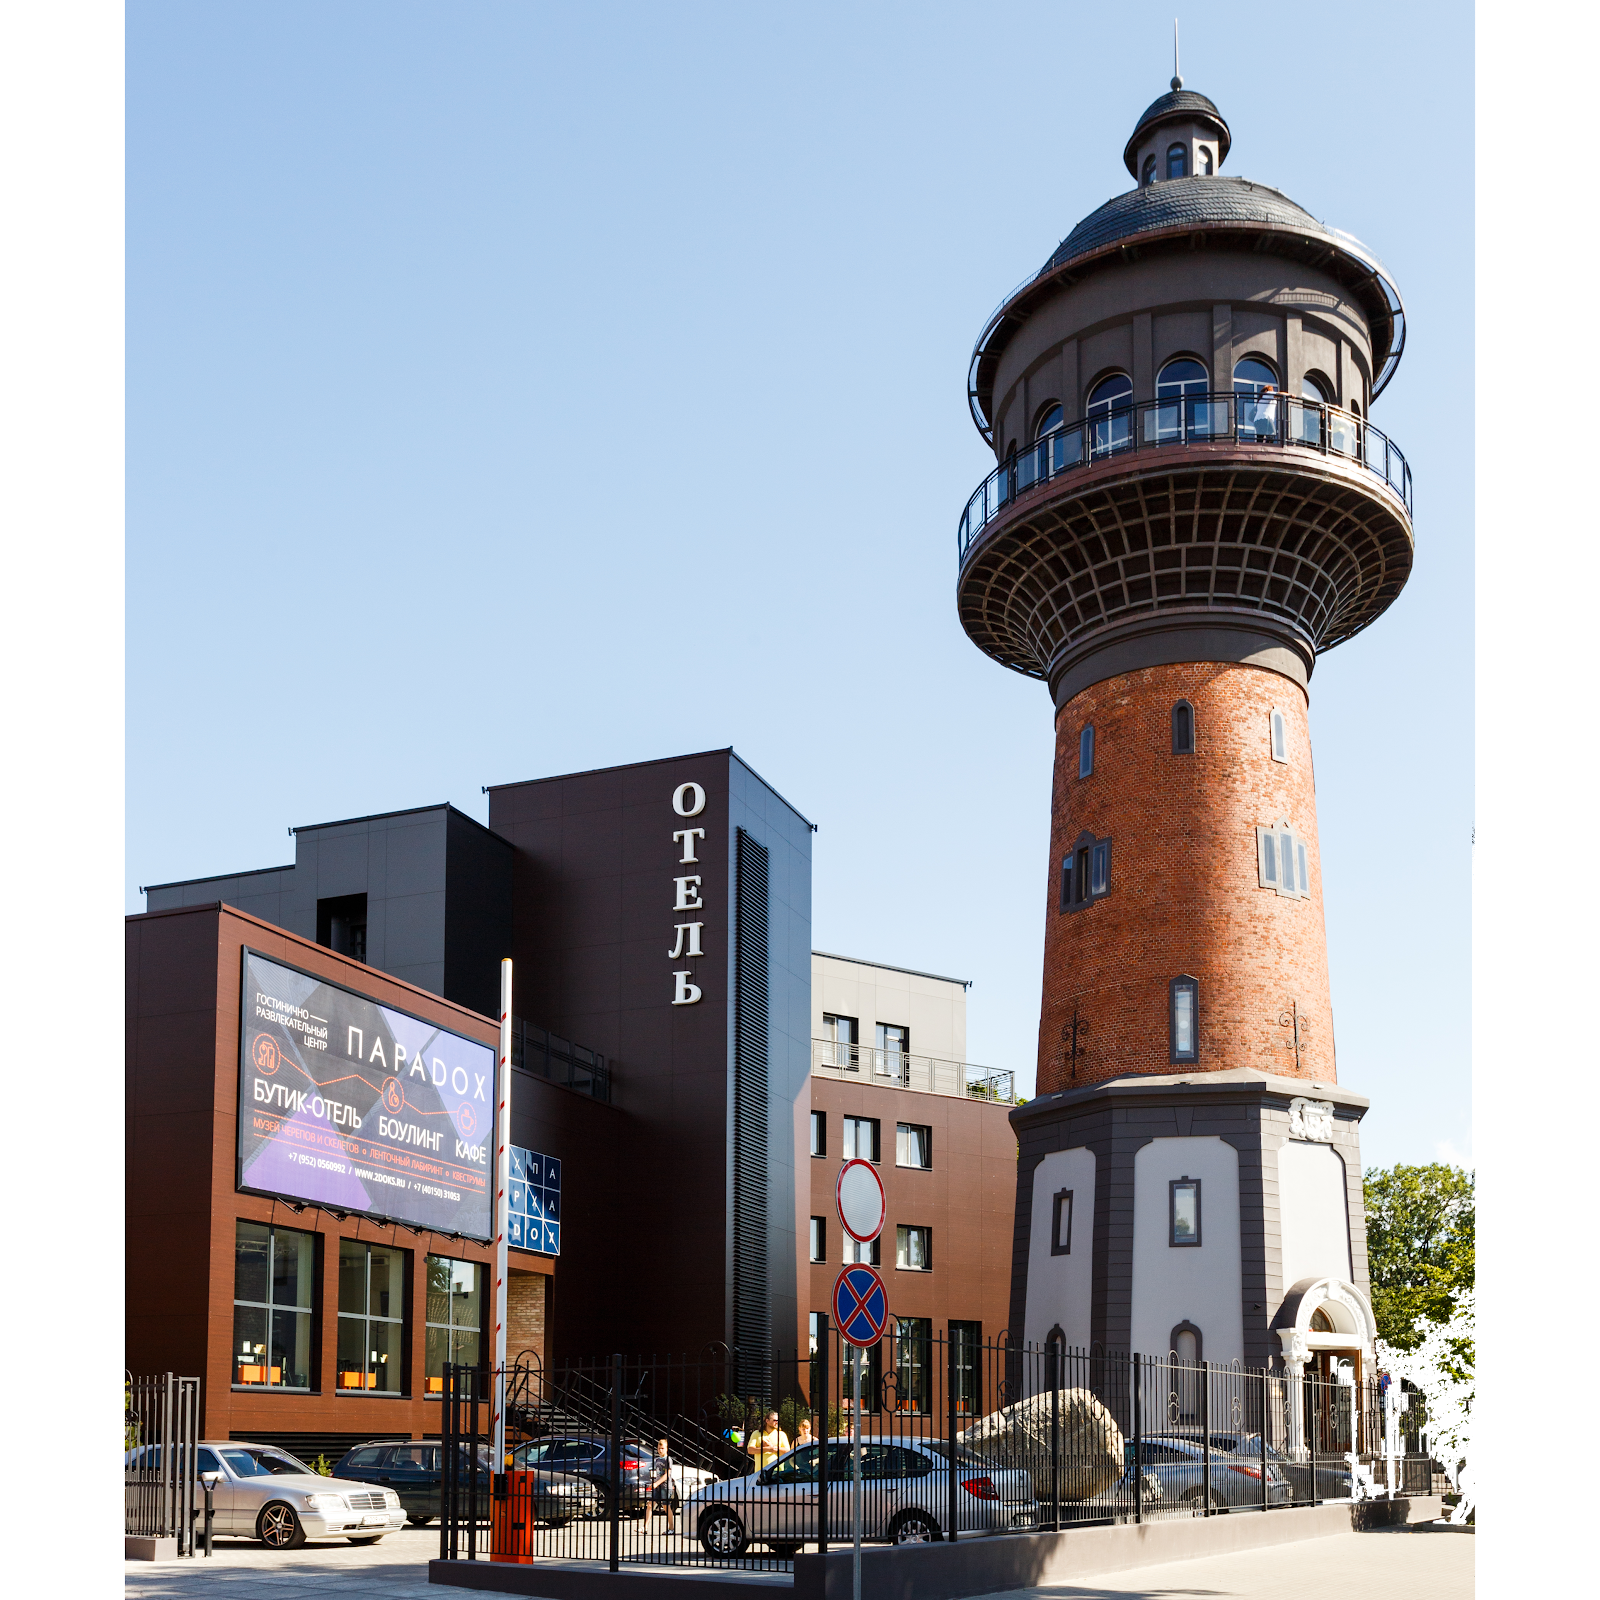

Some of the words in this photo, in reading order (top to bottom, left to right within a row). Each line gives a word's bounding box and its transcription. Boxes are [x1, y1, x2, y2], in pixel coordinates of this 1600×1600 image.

[668, 781, 706, 1006] ОТЕЛЬ
[256, 1005, 328, 1040] РАЗВЛЕКАТЕЛЬНЫЙ
[303, 1035, 328, 1051] ЦЕНТР
[253, 1078, 362, 1129] БУТИК-ОТЕЛЬ
[253, 1117, 280, 1133] МУЗЕЙ
[281, 1124, 316, 1143] ЧЕРЕПОВ
[316, 1134, 323, 1144] И
[323, 1136, 359, 1154] СКЕЛЕТОВ
[369, 1148, 411, 1168] ЛЕНТОЧНЫЙ
[411, 1159, 444, 1176] ЛАБИРИНТ
[452, 1170, 486, 1187] КВЕСТРУМЫ
[379, 1115, 444, 1151] БОУЛИНГ
[455, 1138, 487, 1165] КАФЕ
[288, 1152, 298, 1162] +7
[298, 1154, 317, 1168] (952)
[317, 1158, 346, 1174] 0560992
[354, 1167, 406, 1188] WWW.2DOKS.RU
[413, 1183, 421, 1192] +7
[443, 1190, 461, 1202] 31053
